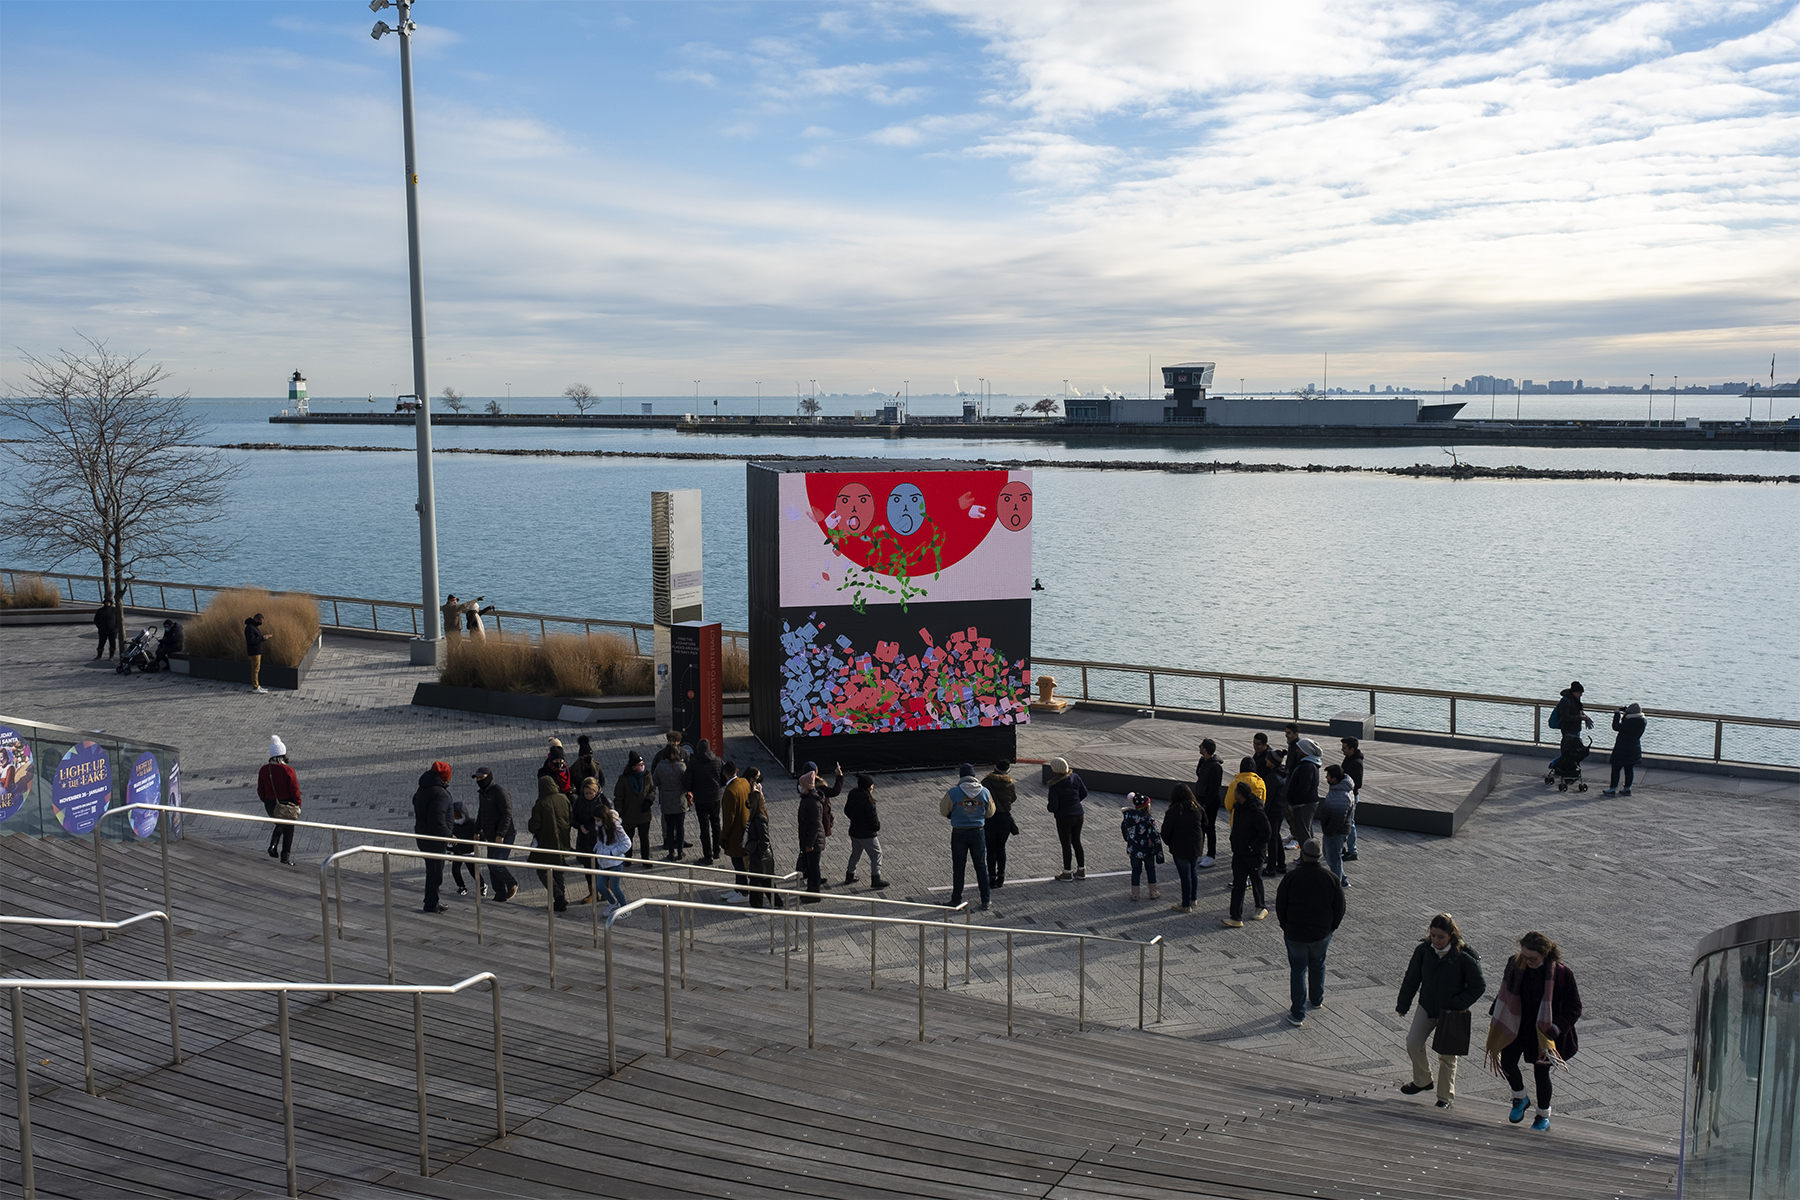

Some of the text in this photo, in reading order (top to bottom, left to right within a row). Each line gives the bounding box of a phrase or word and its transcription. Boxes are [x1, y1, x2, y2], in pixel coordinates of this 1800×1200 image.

[710, 670, 716, 682] TO
[60, 758, 105, 781] LIGHT UP
[68, 769, 106, 788] THE LAKE
[59, 794, 82, 804] NOVEMBER
[89, 787, 104, 797] JANUARY
